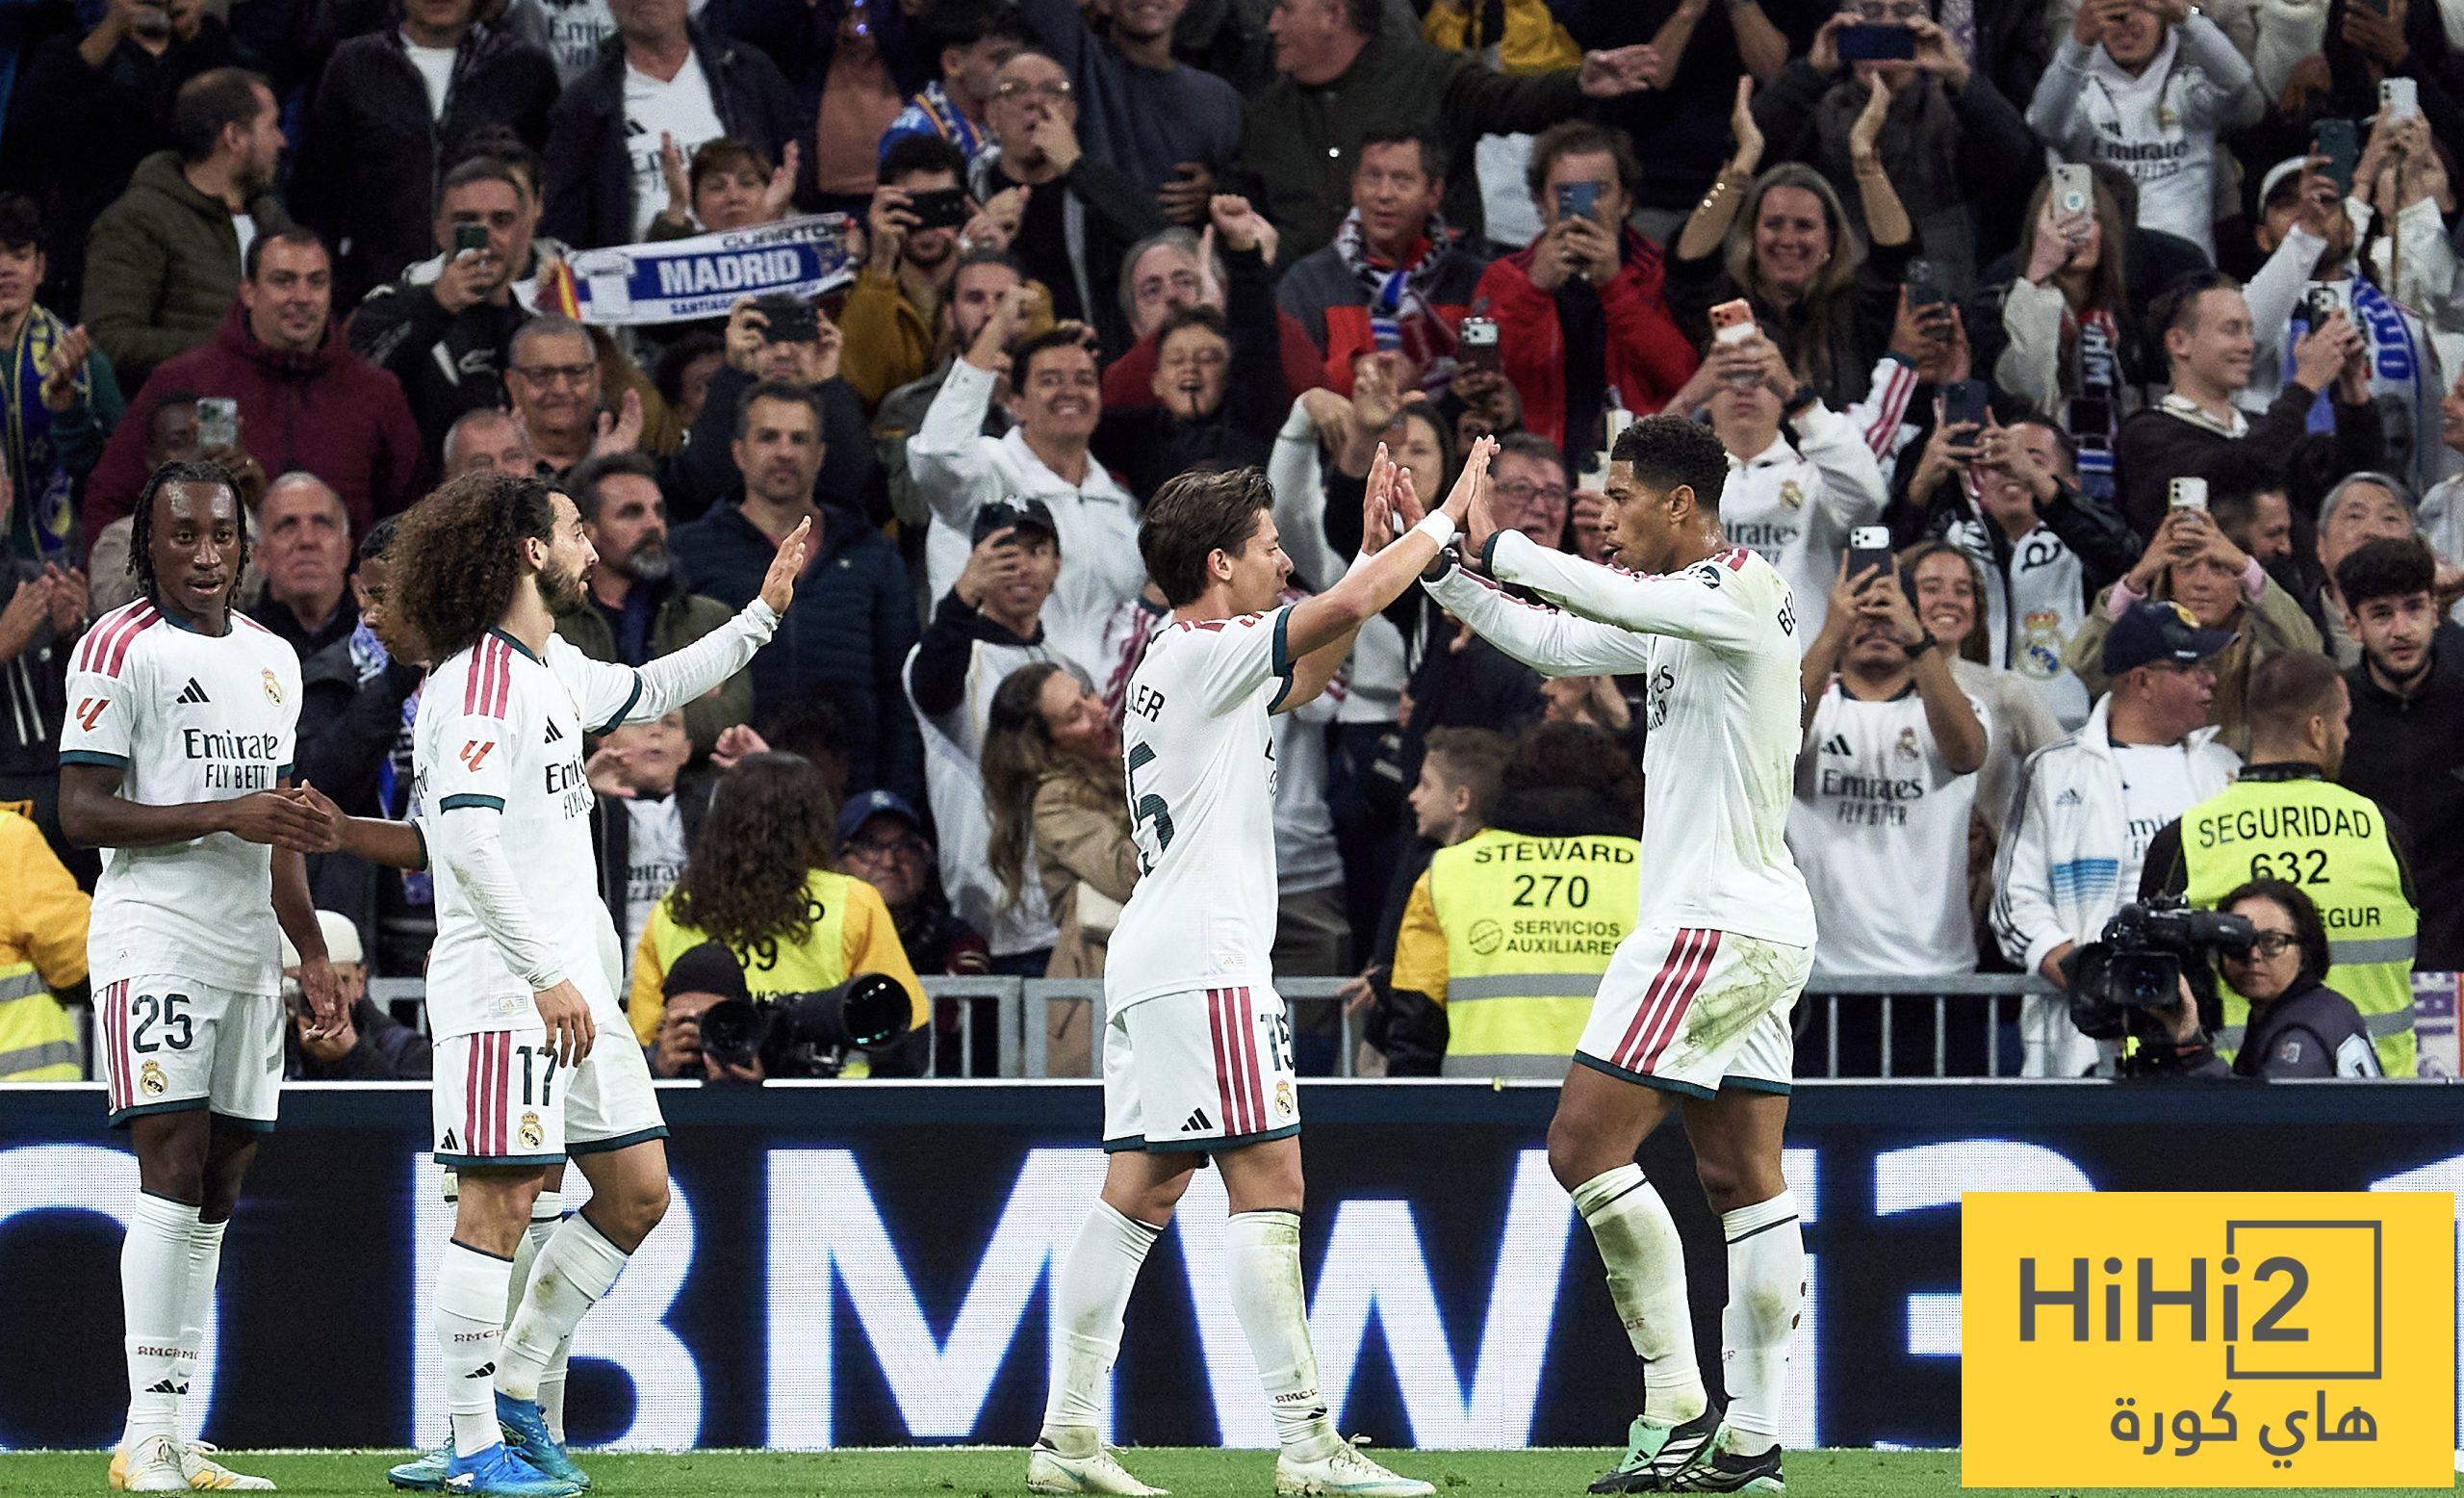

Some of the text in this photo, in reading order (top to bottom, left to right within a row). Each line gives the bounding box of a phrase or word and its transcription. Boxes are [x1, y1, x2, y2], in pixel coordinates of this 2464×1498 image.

[657, 247, 802, 296] MADRID
[205, 764, 270, 789] FLY BETT
[2198, 806, 2372, 849] SEGURIDAD
[1474, 839, 1634, 865] STEWARD
[2249, 849, 2331, 886] 632
[1512, 873, 1589, 909] 270
[1505, 938, 1619, 956] AUXILIARE
[1512, 920, 1621, 937] SERVICIOS
[132, 993, 193, 1054] 25
[516, 1046, 559, 1107] 17
[414, 1149, 1578, 1453] BMW
